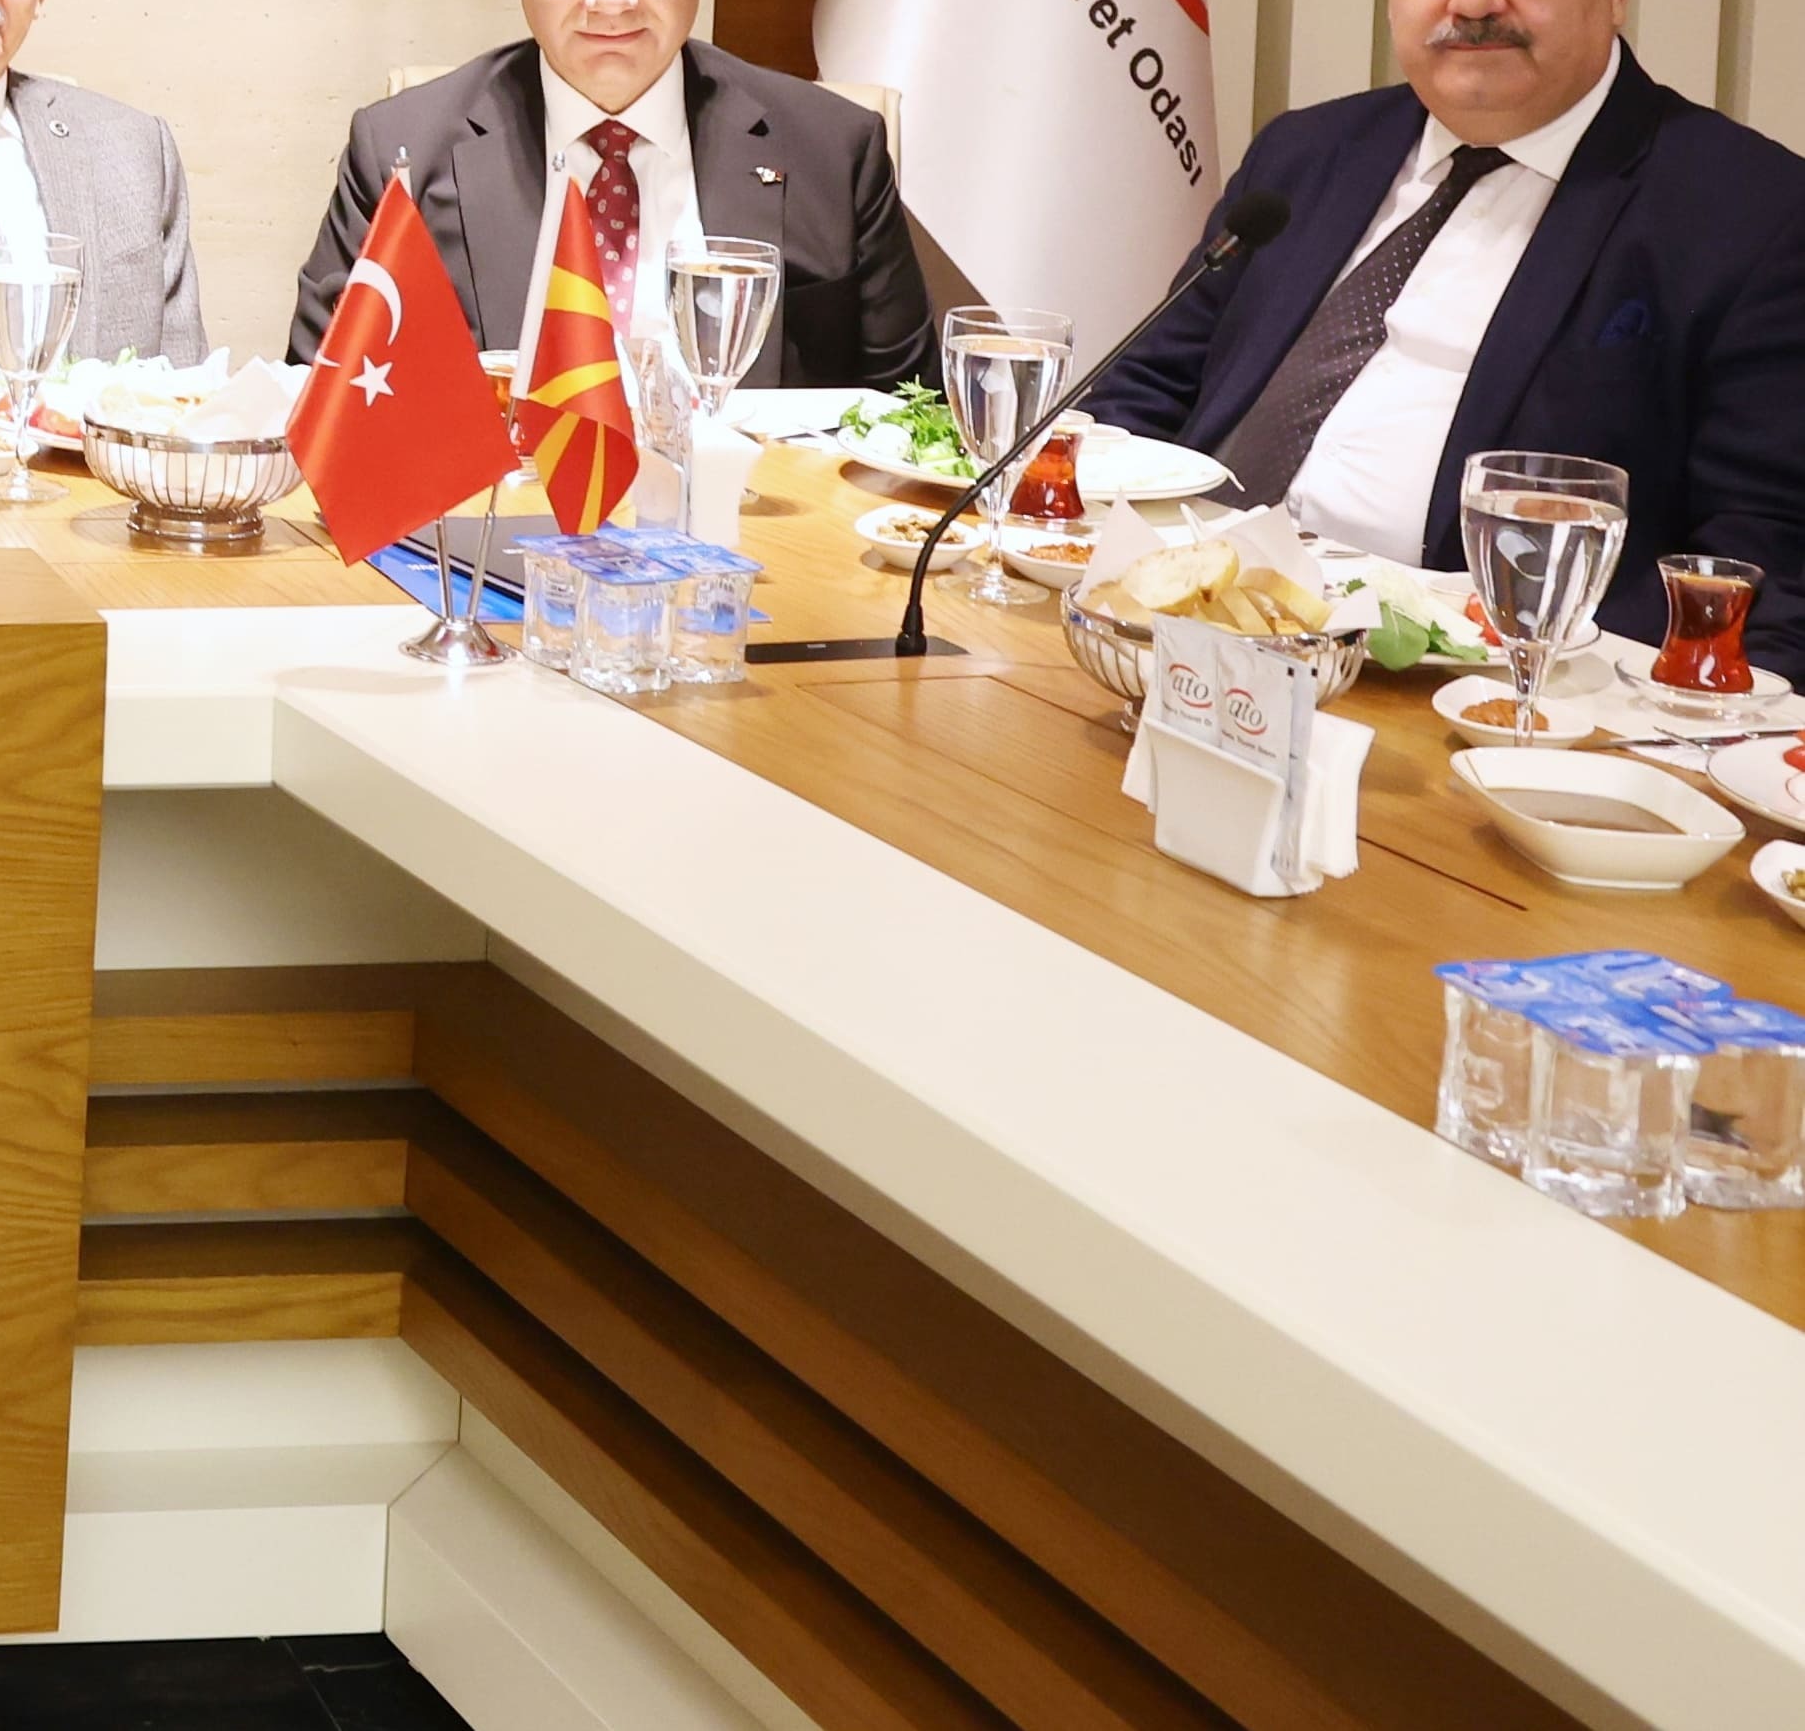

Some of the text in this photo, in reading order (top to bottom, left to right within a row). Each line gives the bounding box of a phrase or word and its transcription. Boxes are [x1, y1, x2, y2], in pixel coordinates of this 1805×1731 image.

[1128, 46, 1203, 187] Odası
[1172, 674, 1209, 700] ato
[1229, 698, 1263, 727] ato
